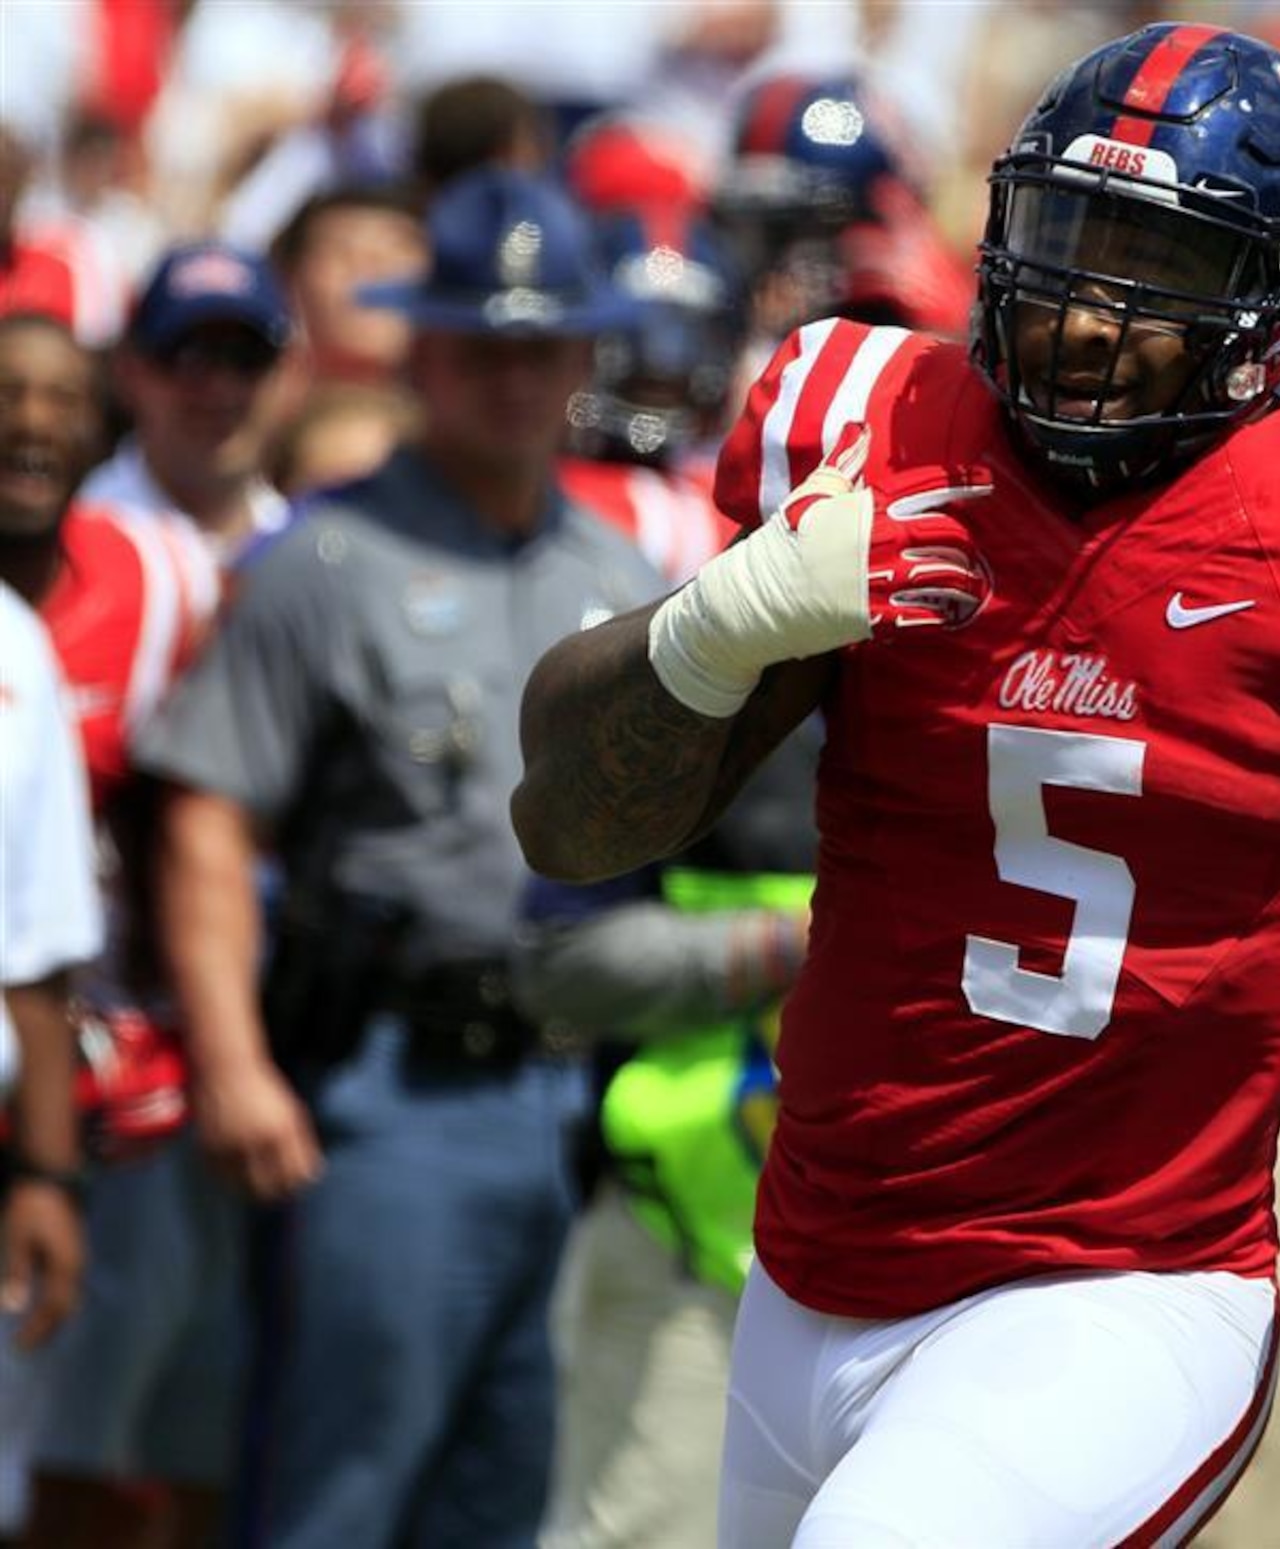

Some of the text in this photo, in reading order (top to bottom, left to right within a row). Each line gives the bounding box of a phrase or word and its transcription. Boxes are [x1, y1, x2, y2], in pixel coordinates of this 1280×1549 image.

[1090, 142, 1146, 175] REBS
[999, 650, 1137, 720] Ole Miss
[961, 722, 1147, 1041] 5
